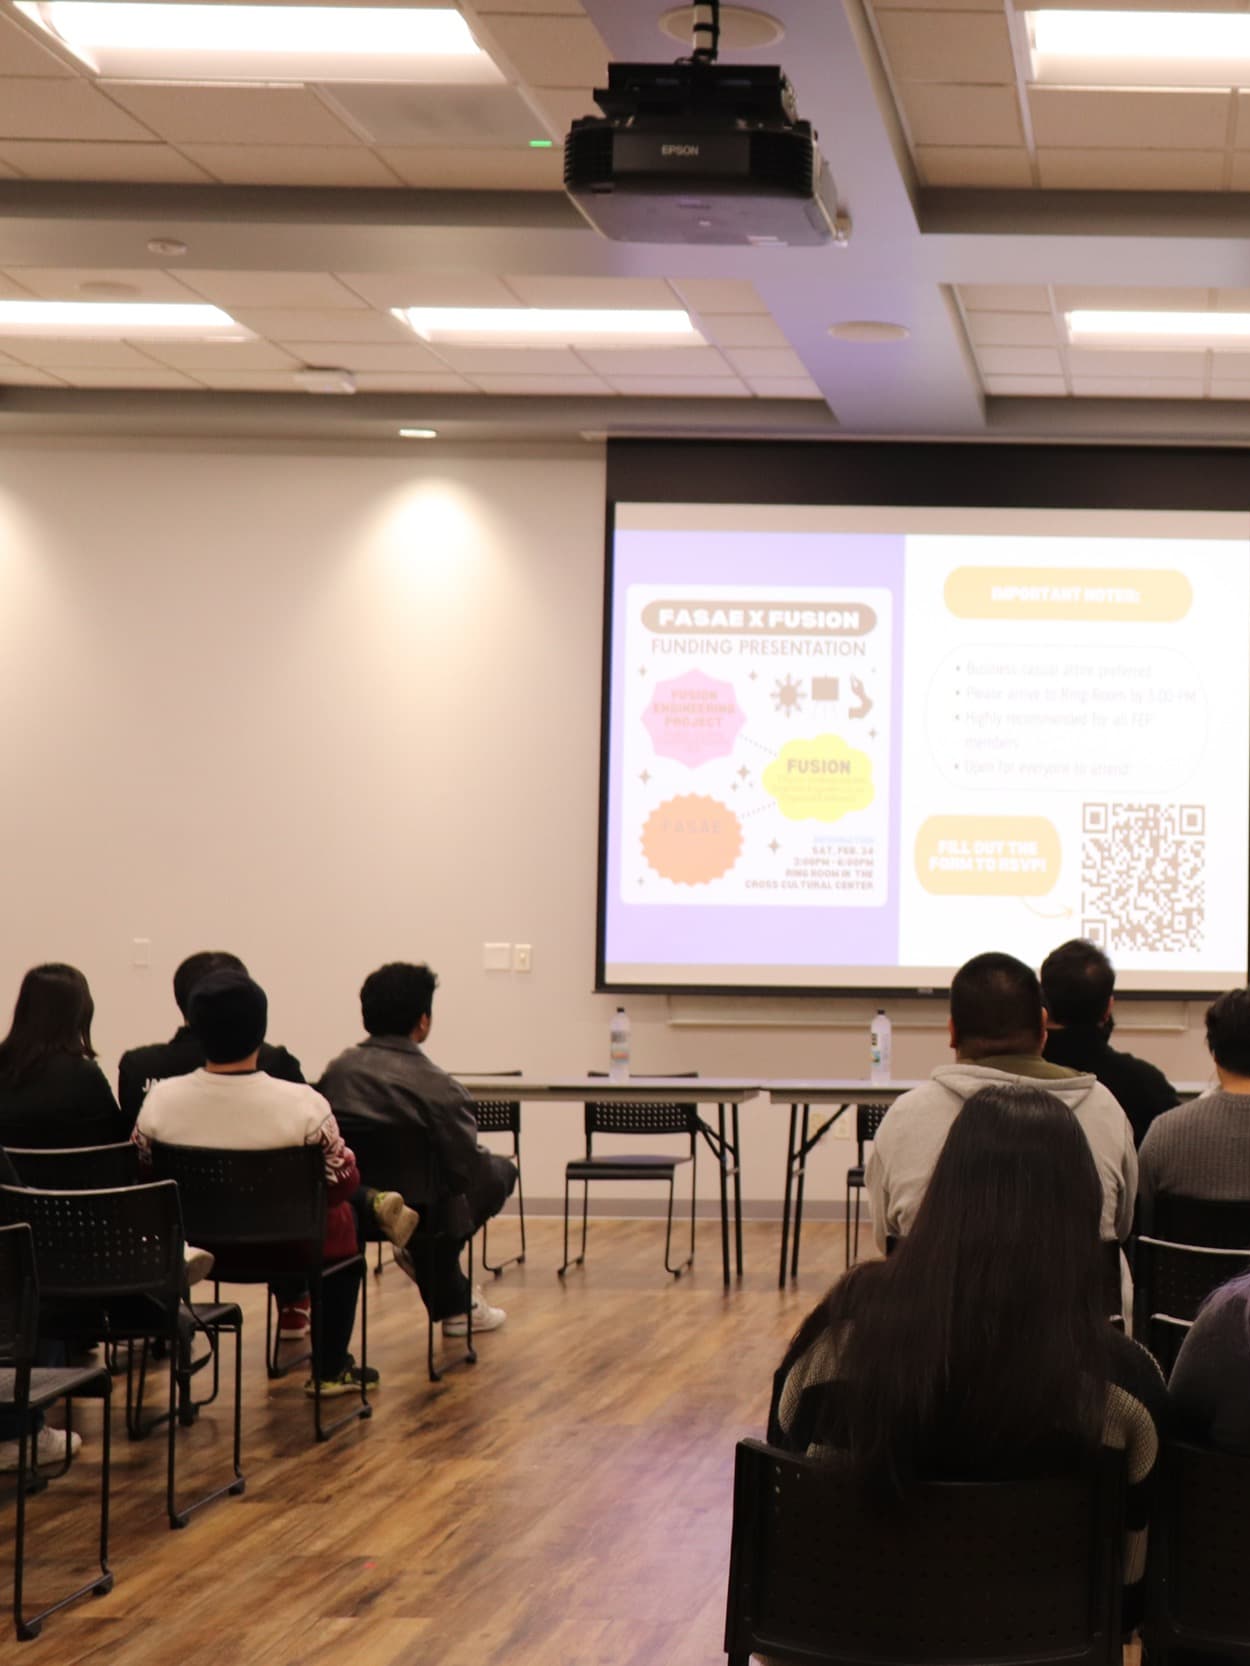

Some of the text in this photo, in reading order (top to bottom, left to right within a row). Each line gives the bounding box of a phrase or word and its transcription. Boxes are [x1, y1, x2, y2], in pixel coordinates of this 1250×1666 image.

[661, 144, 699, 156] EPSON
[659, 608, 860, 630] FASAE X FUSION
[651, 638, 866, 657] FUNDING PRESENTATION
[786, 758, 851, 775] FUSION
[745, 879, 873, 890] CROSS CULTURAL CENTER
